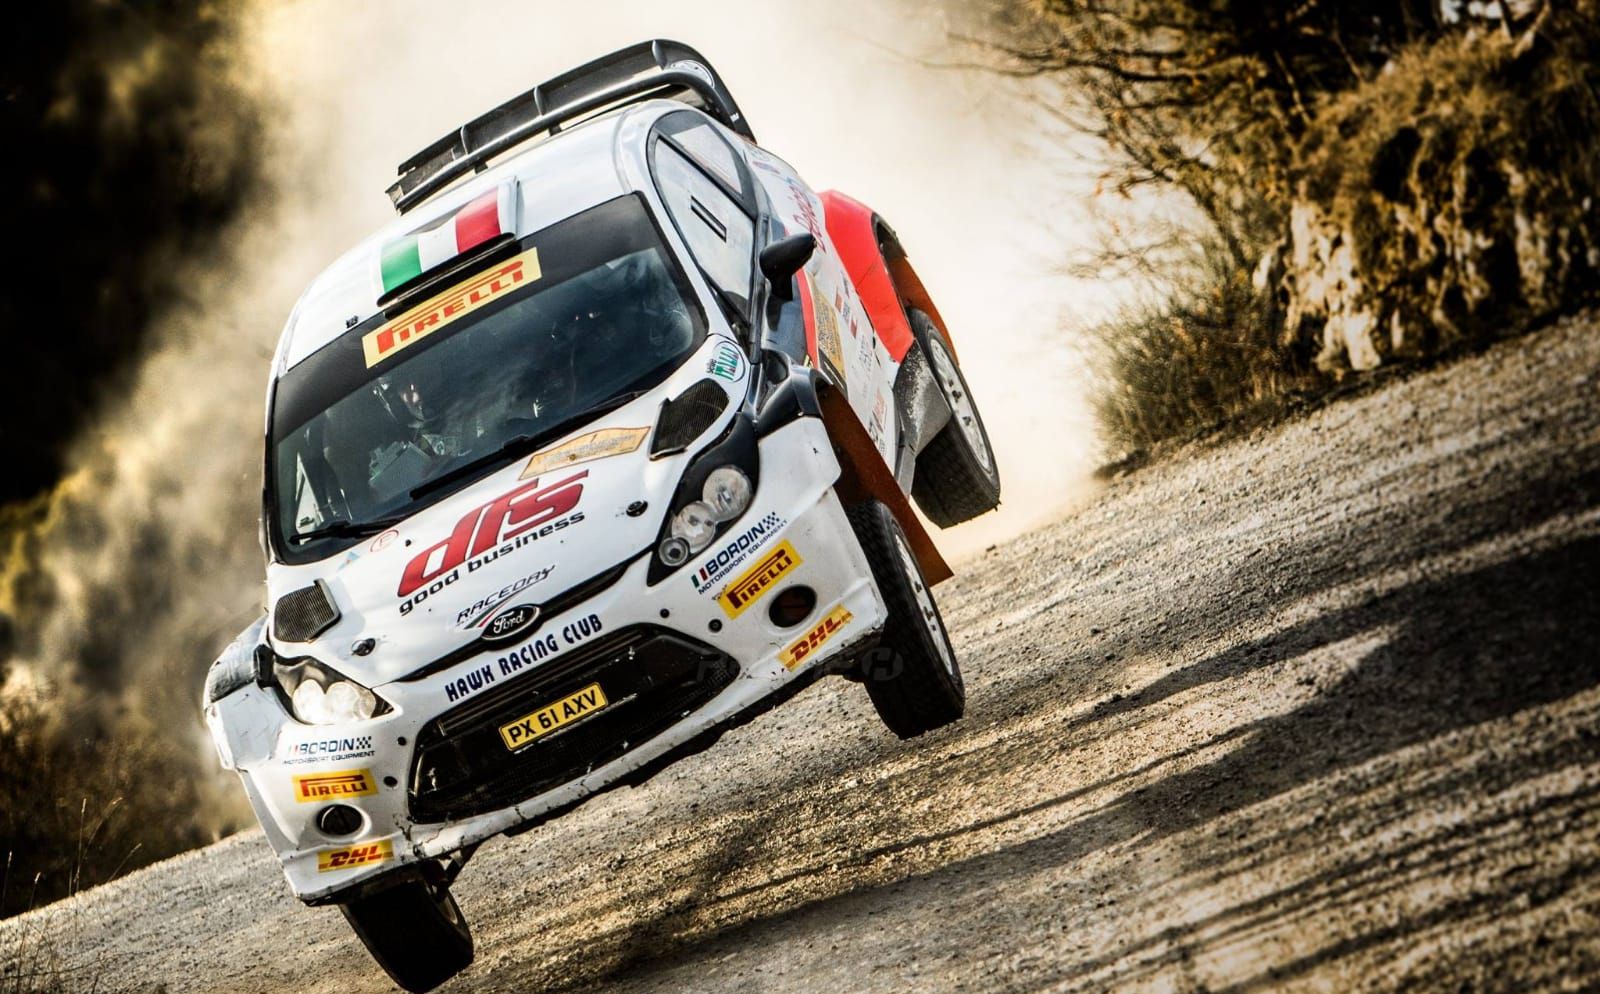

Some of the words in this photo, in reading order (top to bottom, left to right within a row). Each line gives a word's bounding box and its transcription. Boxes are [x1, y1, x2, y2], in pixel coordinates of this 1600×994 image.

[376, 260, 523, 354] PIRELLI
[399, 570, 459, 616] good
[467, 511, 585, 573] business
[699, 553, 748, 594] MOTORSPORT
[749, 520, 788, 554] EQUIPMENT
[705, 523, 765, 575] BORDIN
[456, 565, 555, 623] RACEDAY
[726, 548, 793, 609] PIRELLI
[493, 610, 525, 634] Ford
[790, 617, 842, 664] DHL
[445, 664, 495, 702] HAWK
[498, 633, 559, 677] RACING
[562, 613, 603, 644] CLUB
[508, 718, 536, 743] PX
[537, 706, 559, 729] 61
[564, 689, 597, 719] AXV
[331, 750, 376, 761] EQUIPMENT
[299, 774, 368, 797] PIRELLI
[329, 845, 382, 867] DHL
